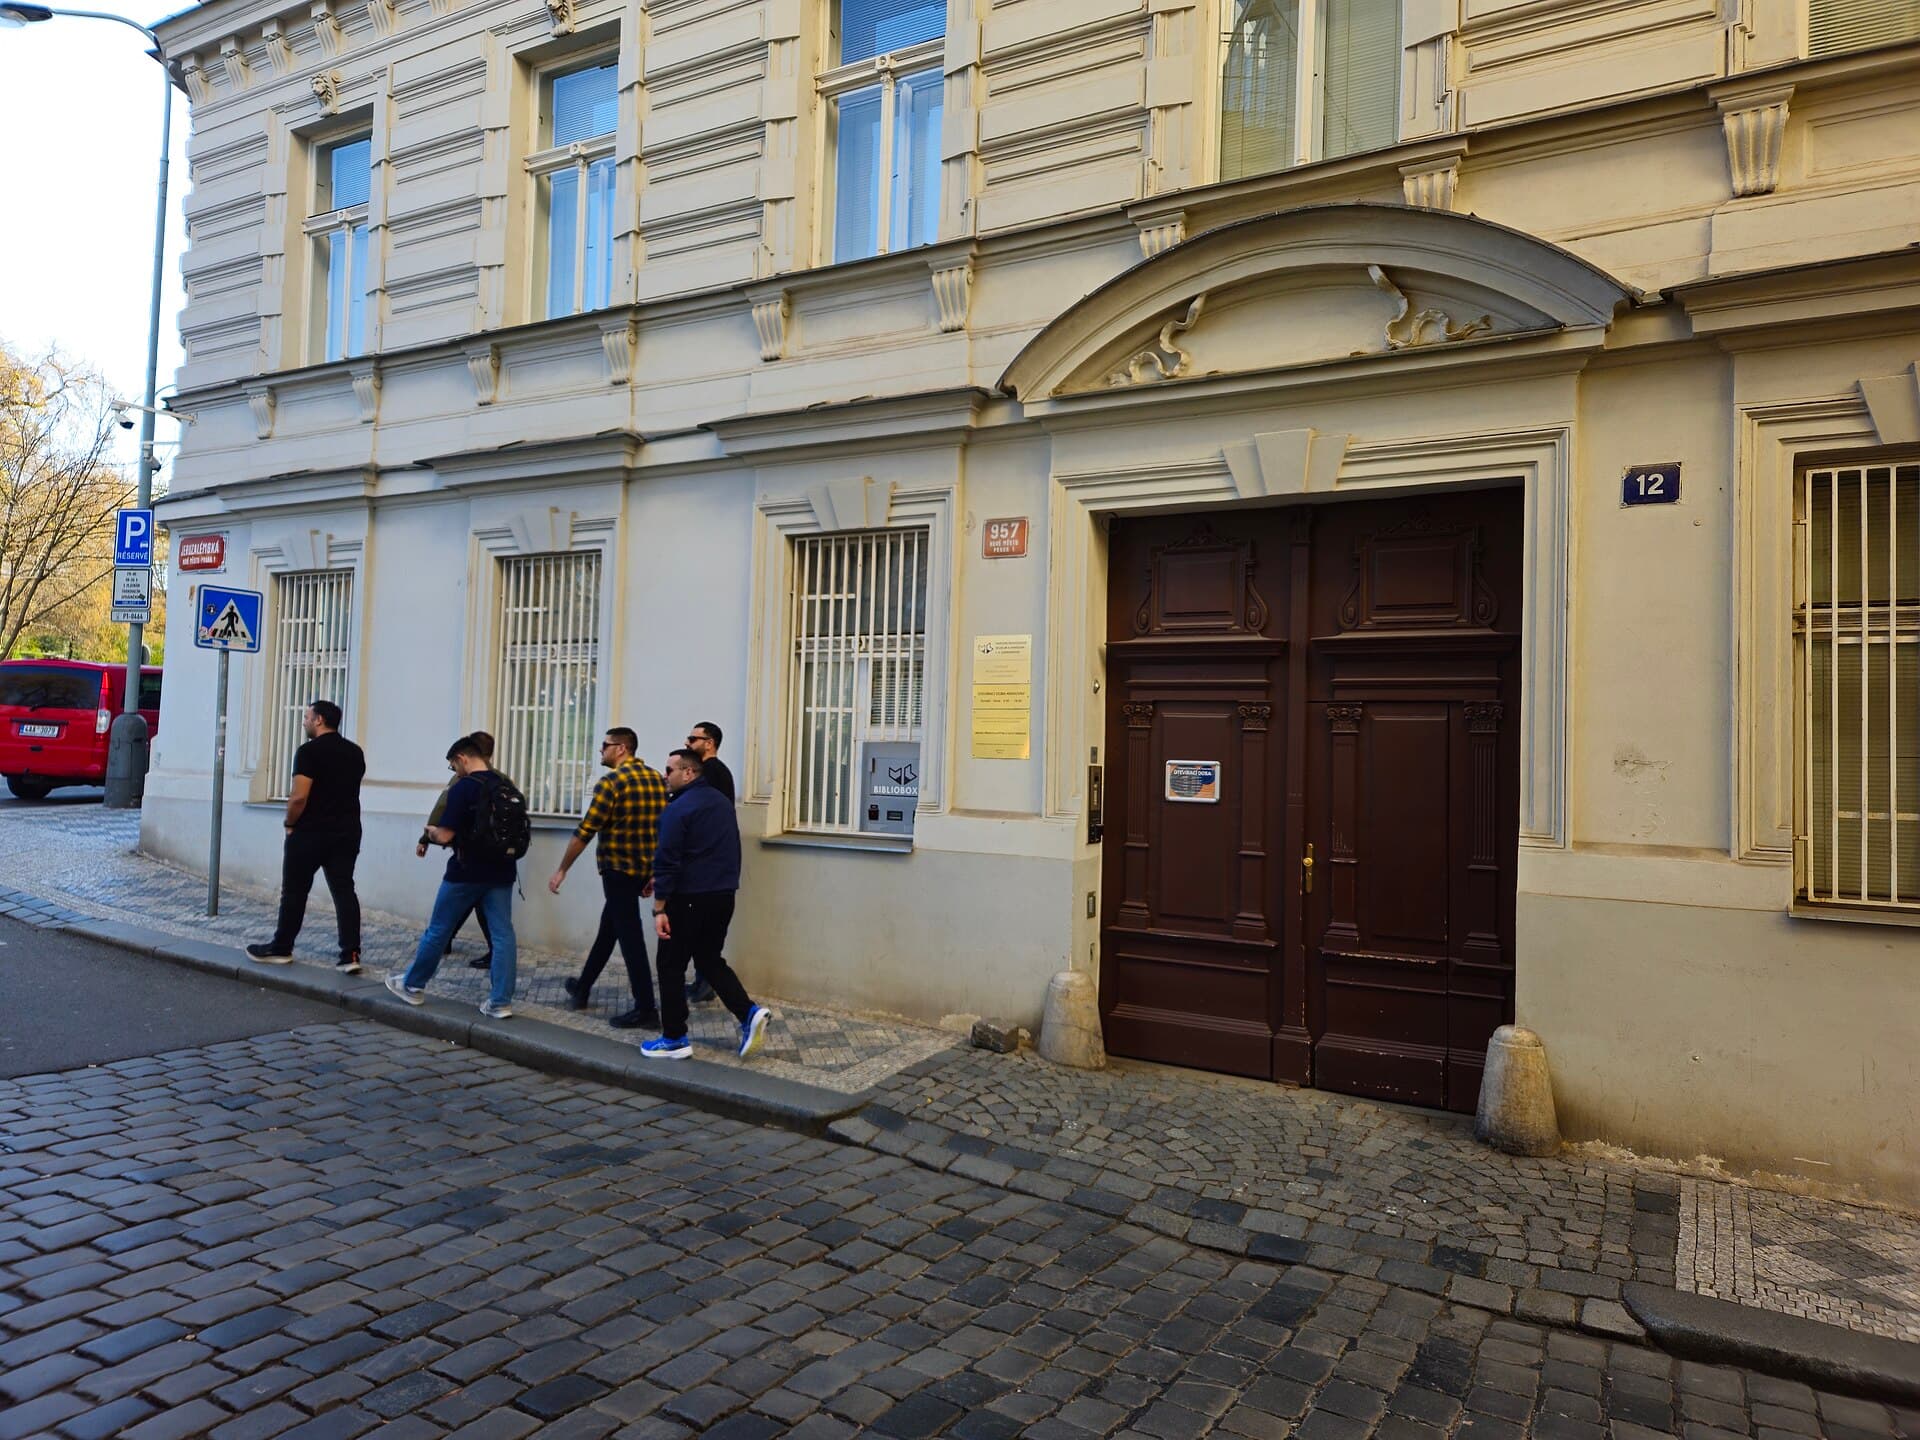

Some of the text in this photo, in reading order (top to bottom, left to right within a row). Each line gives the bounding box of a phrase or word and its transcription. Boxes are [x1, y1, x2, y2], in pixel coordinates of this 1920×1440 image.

[1636, 473, 1664, 496] 12
[125, 516, 146, 548] P
[991, 522, 1019, 539] 957
[181, 540, 219, 556] JERUZALÉMSKÁ
[873, 785, 918, 795] BIBLIOBOX
